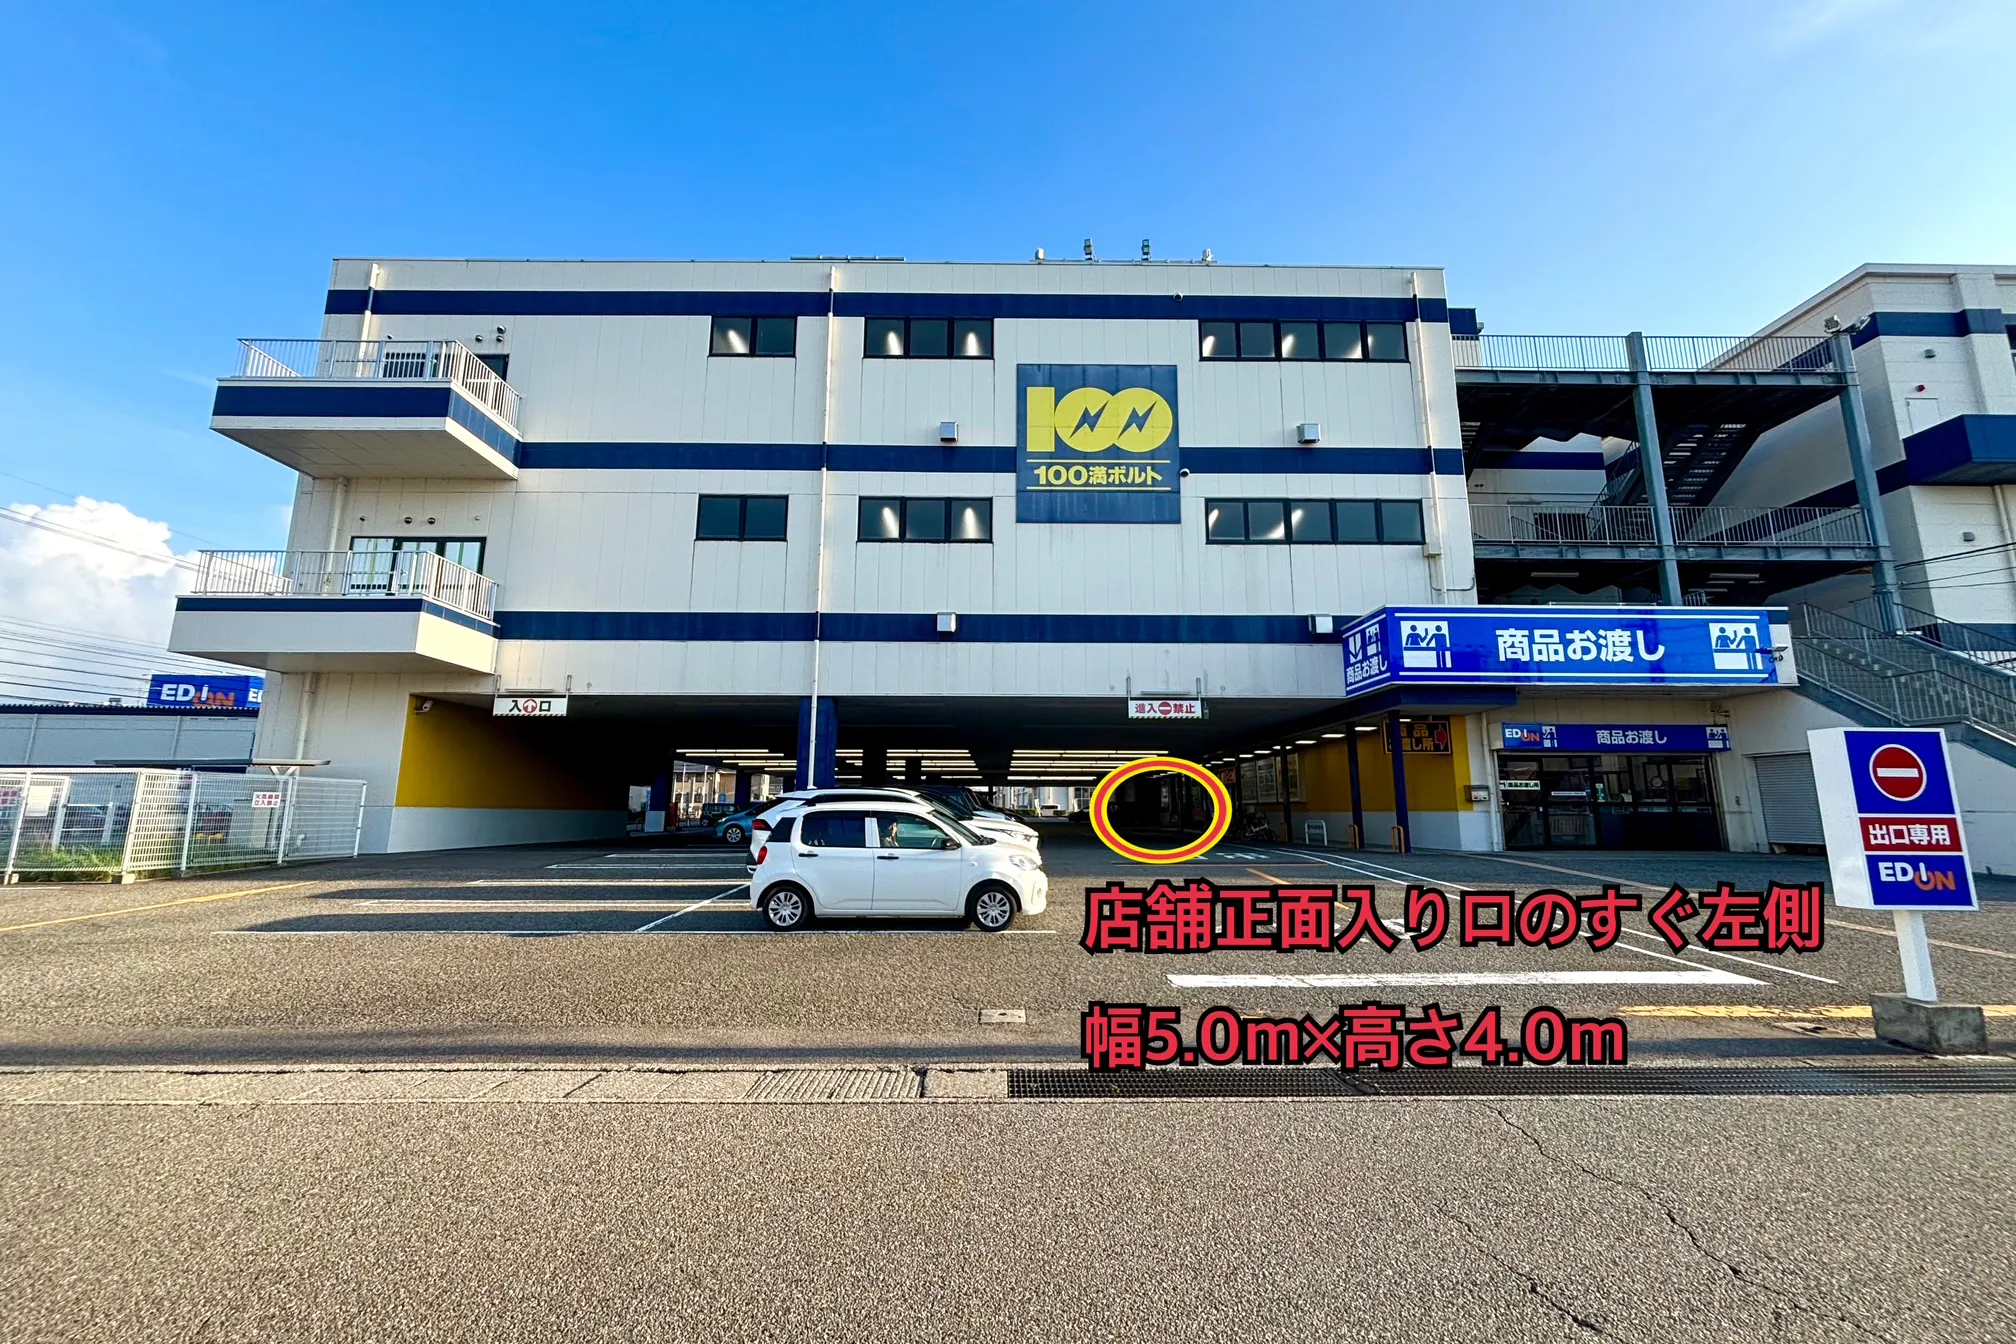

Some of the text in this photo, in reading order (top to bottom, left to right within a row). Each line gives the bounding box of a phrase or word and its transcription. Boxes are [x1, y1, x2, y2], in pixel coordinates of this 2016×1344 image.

[1034, 465, 1163, 486] 100満ボルト
[1496, 628, 1666, 663] 商品お渡し
[1346, 654, 1388, 685] 商品お渡し
[160, 683, 236, 707] EDION
[1505, 728, 1540, 742] EDION
[1596, 729, 1668, 745] 商品お渡し
[1868, 824, 1951, 846] 出口専用
[1878, 862, 1957, 891] EDION
